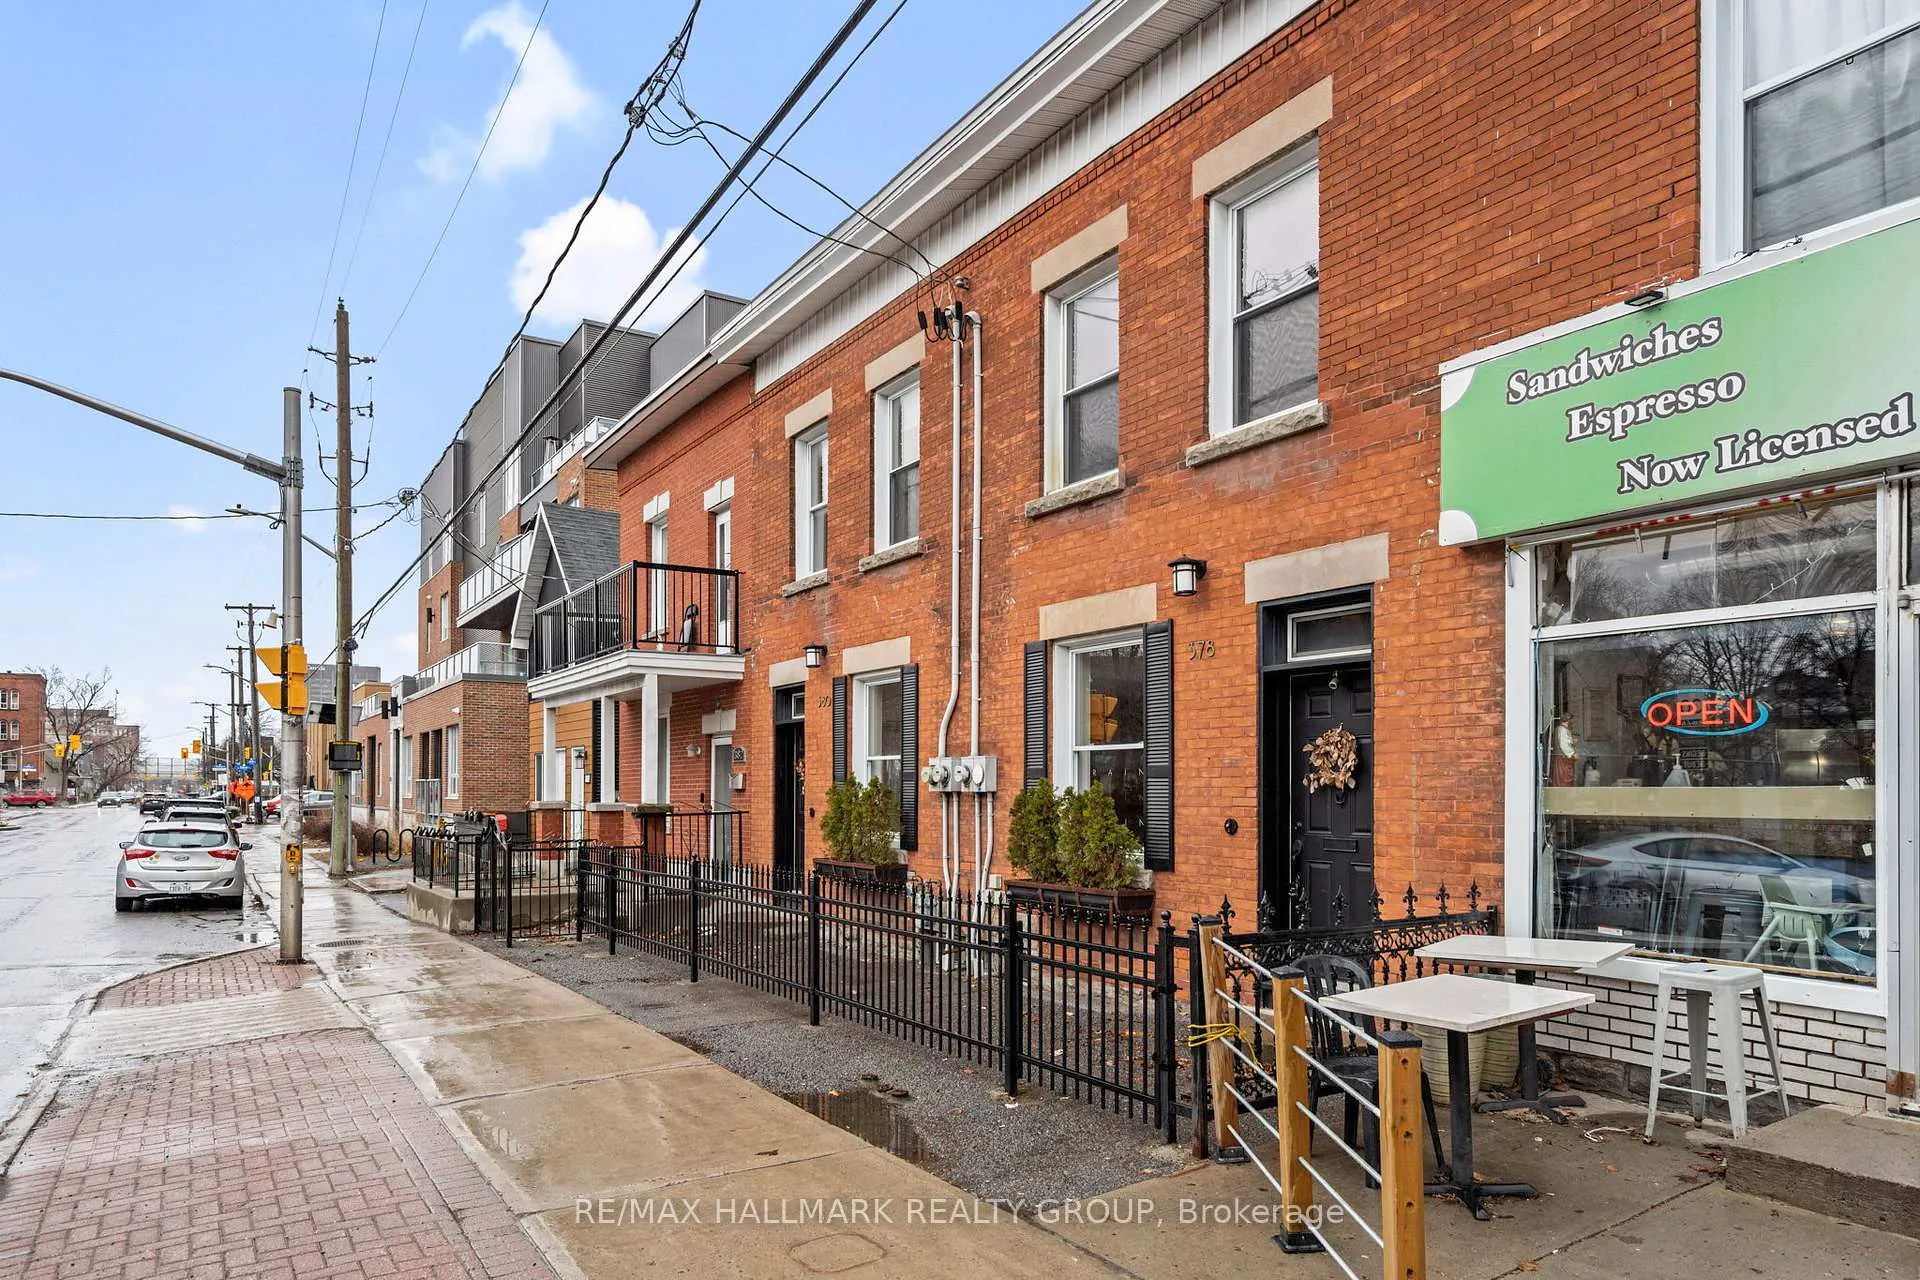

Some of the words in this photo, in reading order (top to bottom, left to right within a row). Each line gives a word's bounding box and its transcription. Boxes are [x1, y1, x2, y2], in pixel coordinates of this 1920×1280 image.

[1507, 316, 1722, 405] Sandwiches
[1566, 372, 1745, 442] Espresso
[1617, 451, 1709, 495] Now
[1715, 392, 1915, 474] Licensed
[1188, 640, 1215, 660] 578
[1648, 698, 1753, 727] OPEN
